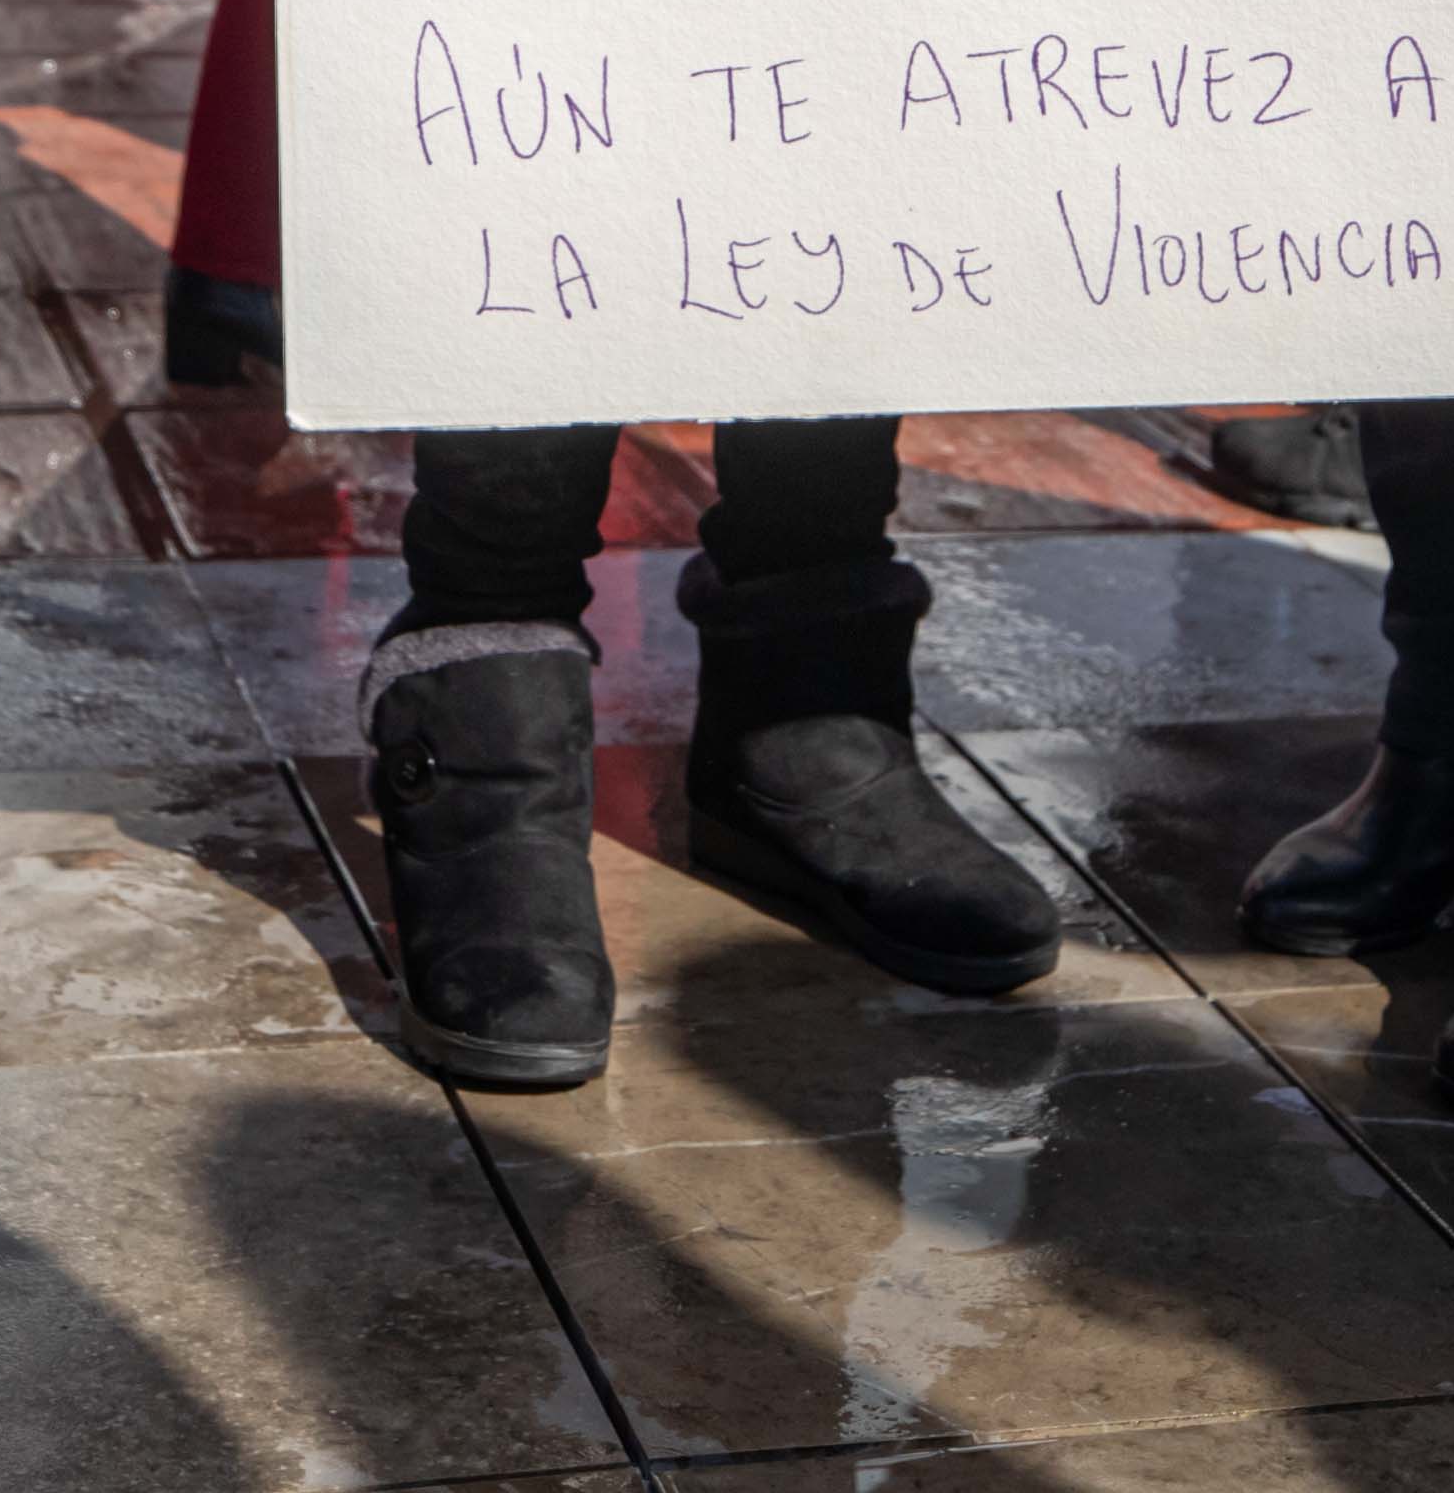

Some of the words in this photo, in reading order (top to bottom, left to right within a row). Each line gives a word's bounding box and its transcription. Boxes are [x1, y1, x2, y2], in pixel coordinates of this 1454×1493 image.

[413, 19, 613, 165] AÚN
[691, 58, 813, 143] TE
[900, 33, 1313, 131] ATREVEZ
[1384, 35, 1443, 124] A
[476, 227, 598, 319] LA
[893, 240, 993, 313] DE
[1056, 163, 1442, 306] VIOLENCIA
